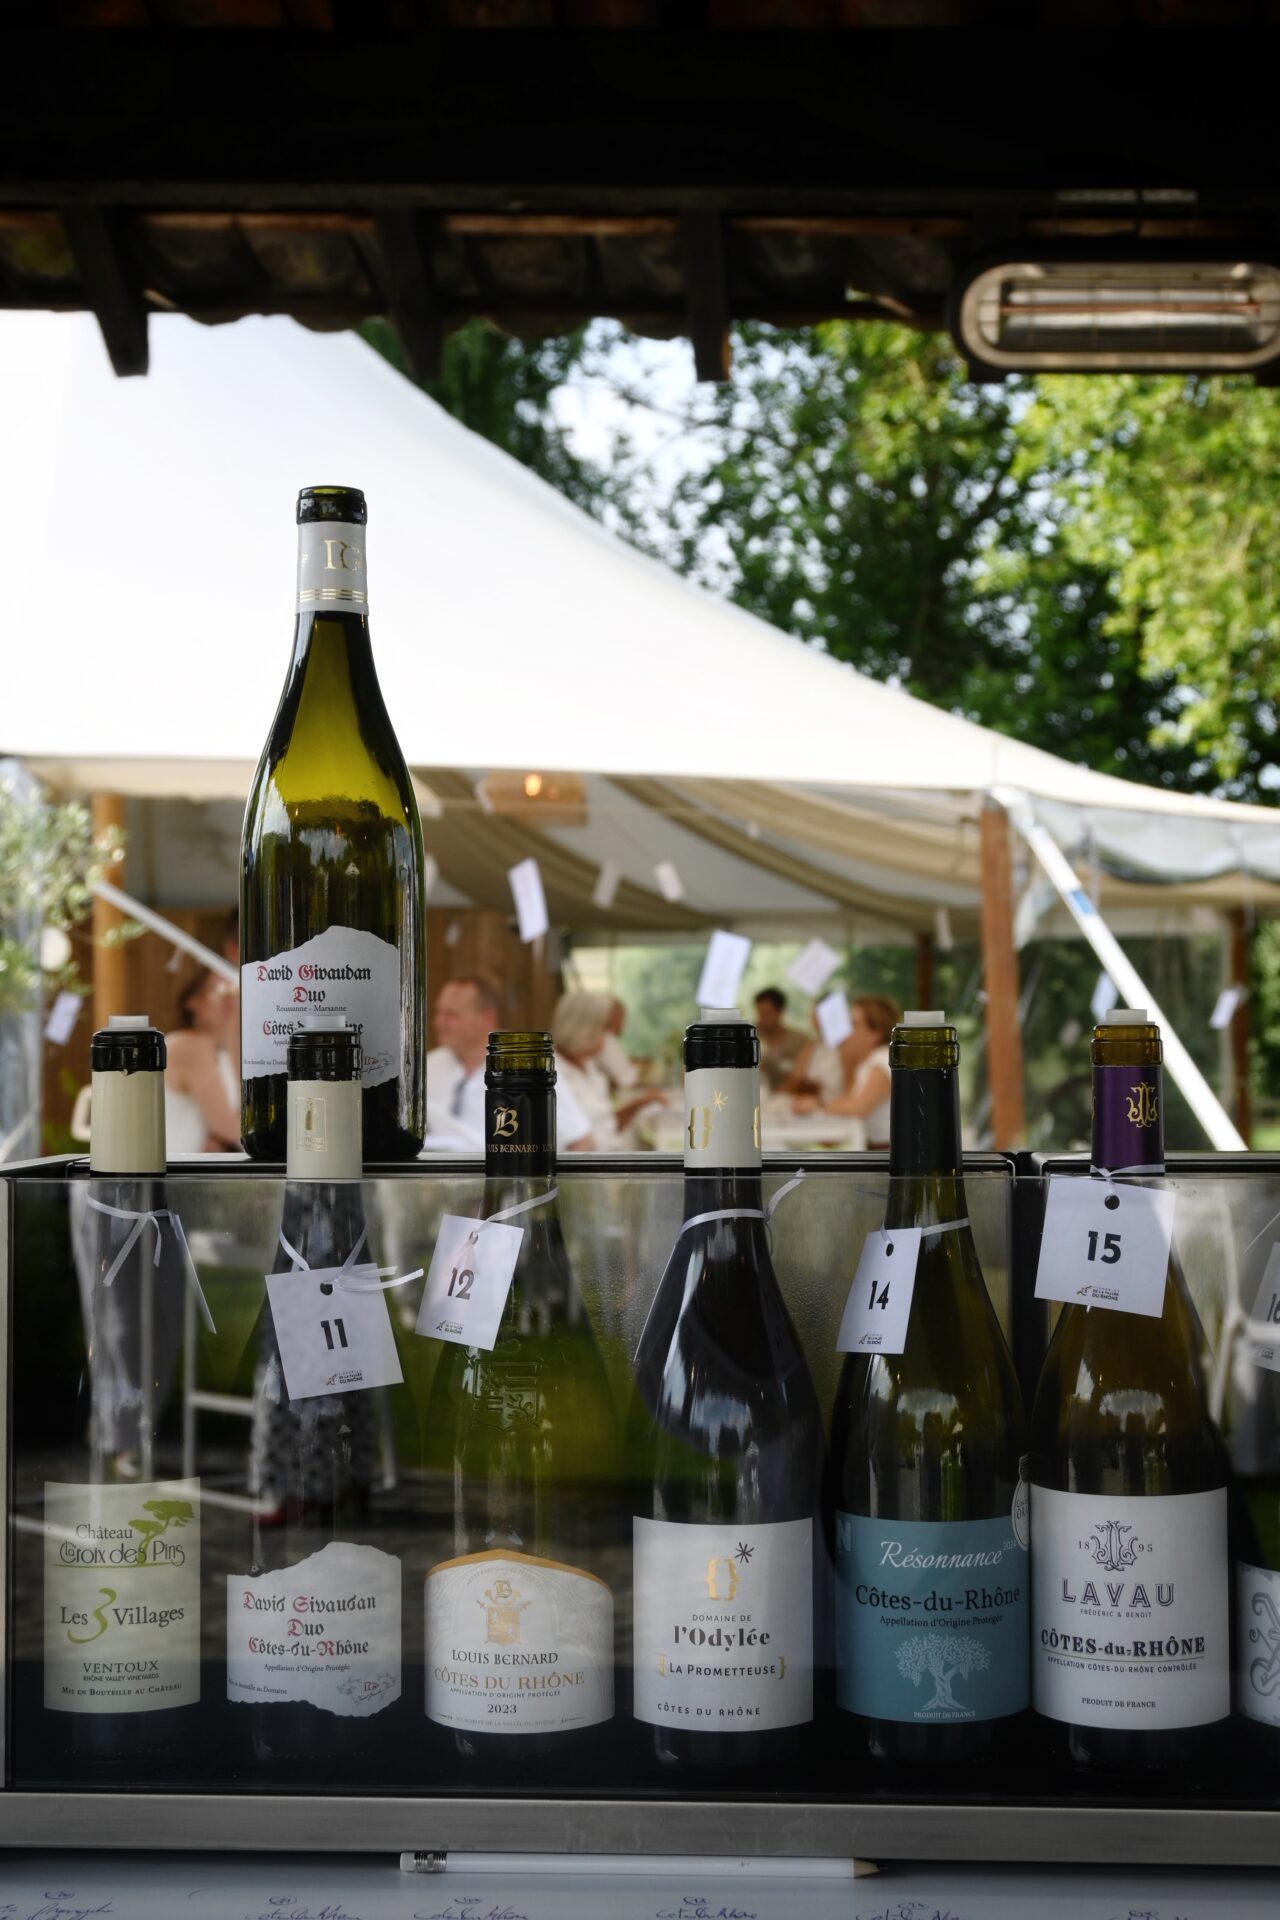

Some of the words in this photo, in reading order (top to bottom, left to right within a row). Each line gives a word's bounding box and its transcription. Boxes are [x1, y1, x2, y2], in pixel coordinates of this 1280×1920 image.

[257, 964, 293, 982] David
[298, 964, 372, 982] Givaudan
[293, 986, 326, 1003] Duo
[276, 1004, 307, 1013] Roussanne
[313, 1004, 347, 1013] Marsanne
[500, 1144, 538, 1153] BERNARD
[1087, 1230, 1121, 1264] 15
[447, 1267, 475, 1300] 12
[868, 1280, 891, 1310] 14
[320, 1318, 348, 1350] 11
[76, 1524, 133, 1540] Château
[109, 1543, 147, 1564] des
[153, 1540, 186, 1567] Pins
[879, 1541, 1003, 1569] Résonnance
[855, 1585, 1021, 1611] Côtes-du-Rhône
[1061, 1577, 1175, 1608] LAVAU
[243, 1591, 286, 1612] David
[60, 1607, 89, 1625] Les
[67, 1587, 117, 1644] 3
[112, 1606, 185, 1628] Villages
[692, 1614, 736, 1622] DOMAINE
[739, 1614, 752, 1622] DE
[1080, 1608, 1114, 1617] FRÉDÉRIC
[287, 1618, 325, 1637] Duo
[880, 1615, 928, 1627] Appellation
[930, 1617, 970, 1629] d'Origine
[972, 1614, 1003, 1626] Protégée
[674, 1625, 771, 1652] l'Odylée
[452, 1649, 490, 1665] LOUIS
[494, 1652, 559, 1666] BERNARD
[1047, 1656, 1085, 1670] APPELLATION
[1087, 1663, 1155, 1673] CÔTES-DU-RHÔNE
[1157, 1662, 1197, 1673] CONTRÔLÉE
[82, 1660, 159, 1674] VENTOUX
[264, 1663, 295, 1673] Appellation
[296, 1664, 324, 1674] d'Origine
[83, 1674, 104, 1682] RHÔNE
[127, 1673, 160, 1681] VINEYARDS
[434, 1666, 479, 1688] CÔTES
[485, 1676, 511, 1690] DU
[518, 1671, 585, 1690] RHÔNE
[263, 1685, 288, 1695] Domaine
[450, 1687, 487, 1698] APPELLATION
[489, 1691, 525, 1699] D'ORIGINE
[527, 1689, 561, 1699] PROTÉGÉE
[487, 1703, 518, 1714] 2023
[657, 1702, 690, 1715] CÔTES
[696, 1708, 712, 1716] DU
[719, 1706, 761, 1717] RHÔNE
[1081, 1697, 1112, 1707] PRODUIT
[1114, 1700, 1125, 1708] DE
[913, 1711, 941, 1719] PRODUIT
[942, 1711, 951, 1719] DE
[952, 1710, 976, 1719] FRANCE
